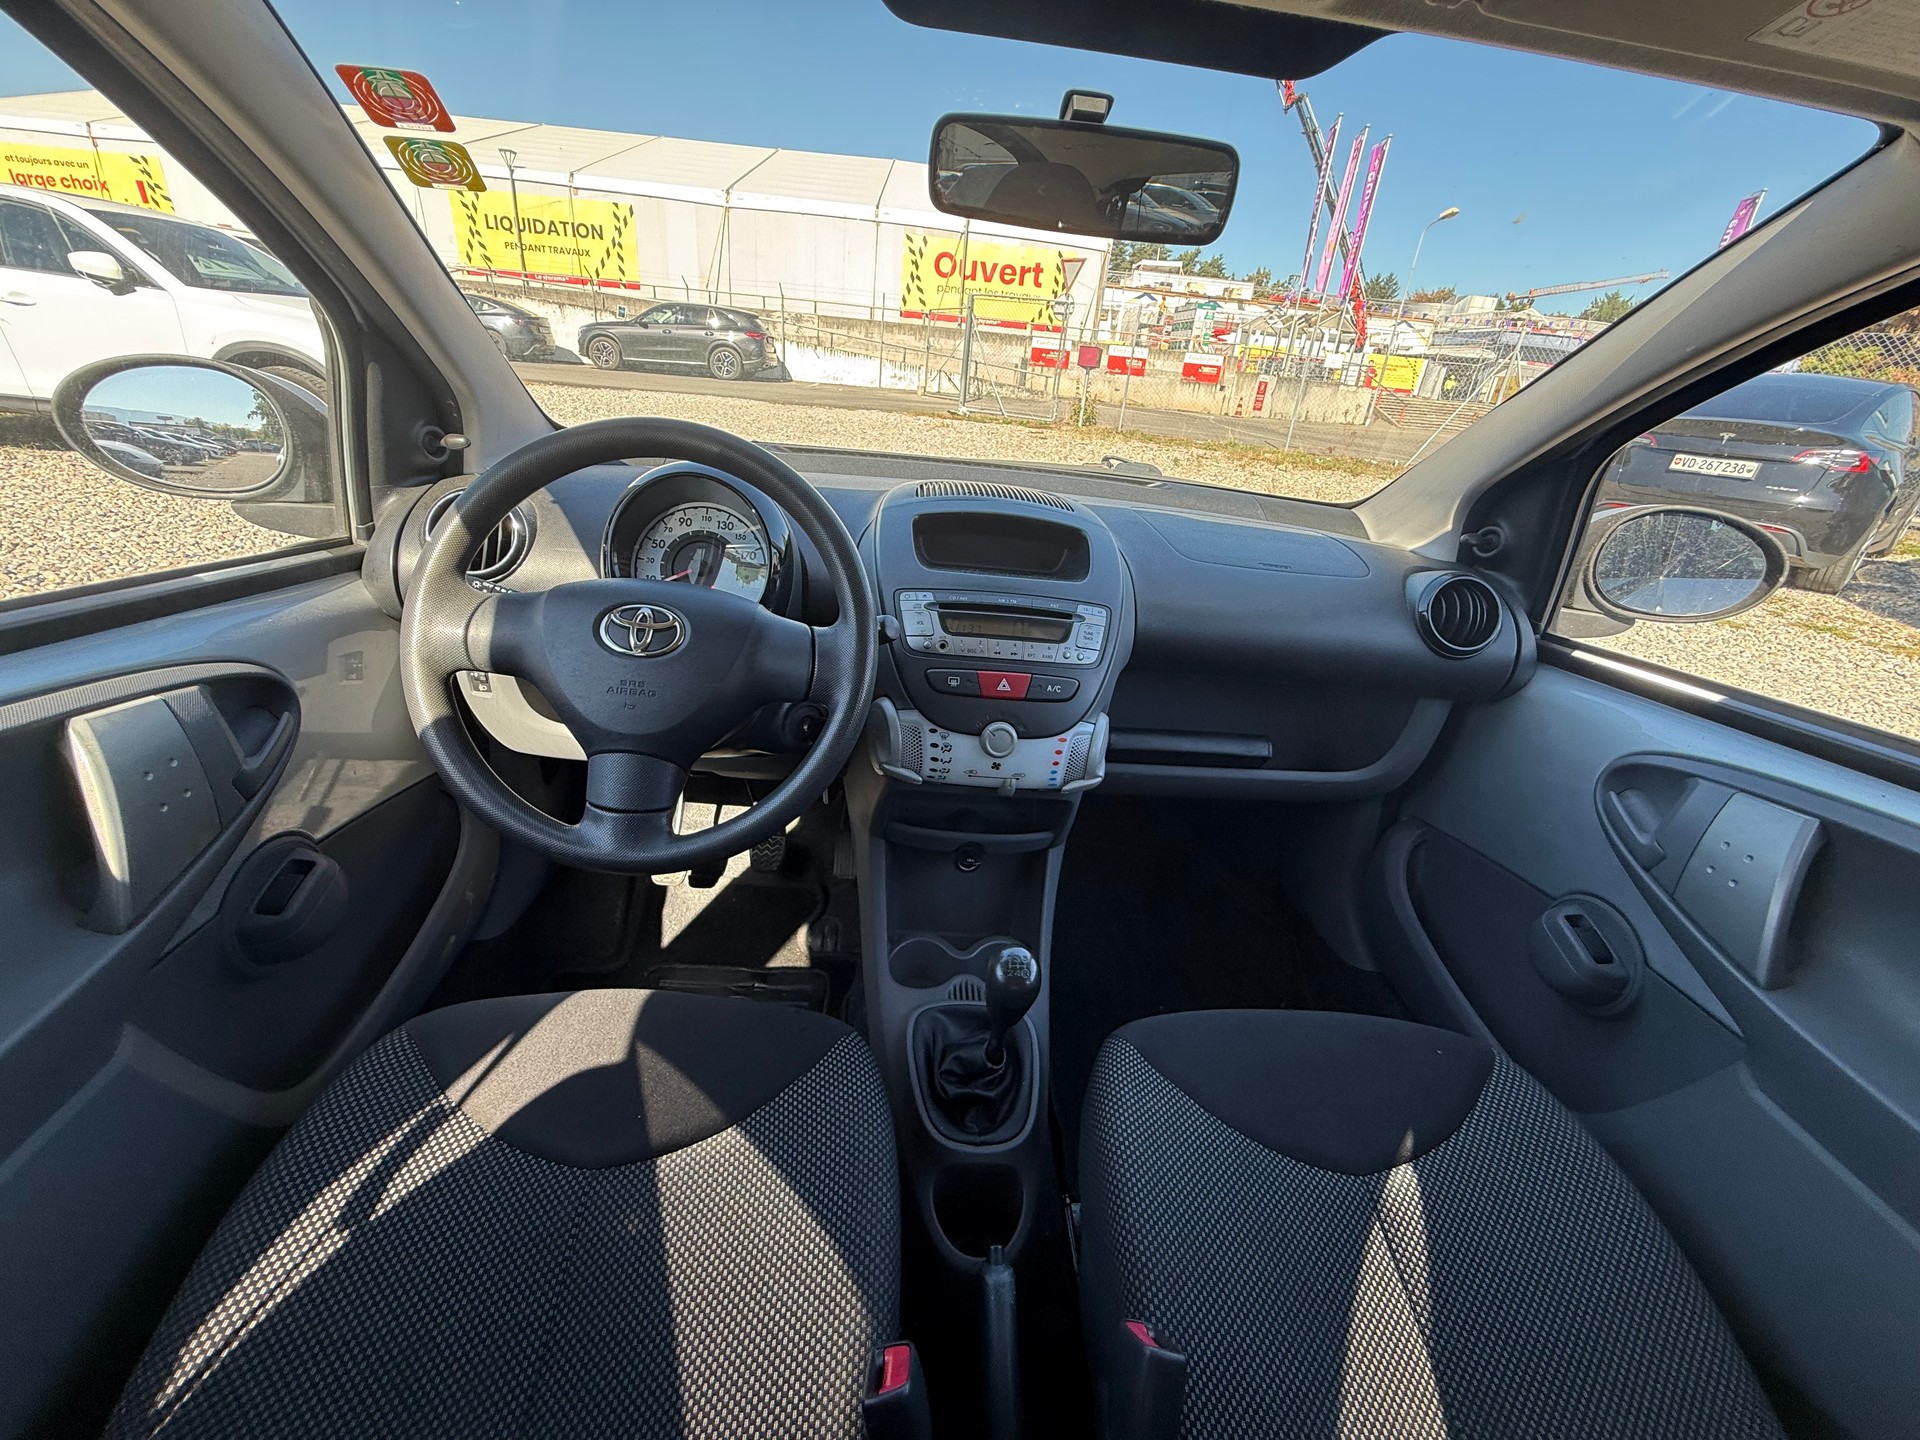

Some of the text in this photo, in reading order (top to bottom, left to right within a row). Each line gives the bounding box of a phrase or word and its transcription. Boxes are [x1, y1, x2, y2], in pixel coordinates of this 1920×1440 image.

[15, 155, 52, 166] toujours
[8, 168, 109, 192] large choix
[484, 214, 604, 240] LIQUIDATION
[504, 242, 591, 257] PENDANT TRAVAUX
[934, 252, 1043, 288] Ouvert
[679, 517, 692, 527] 90
[717, 521, 734, 530] 130
[651, 540, 665, 548] 50
[741, 551, 756, 560] 170
[606, 687, 657, 697] AIRBAG
